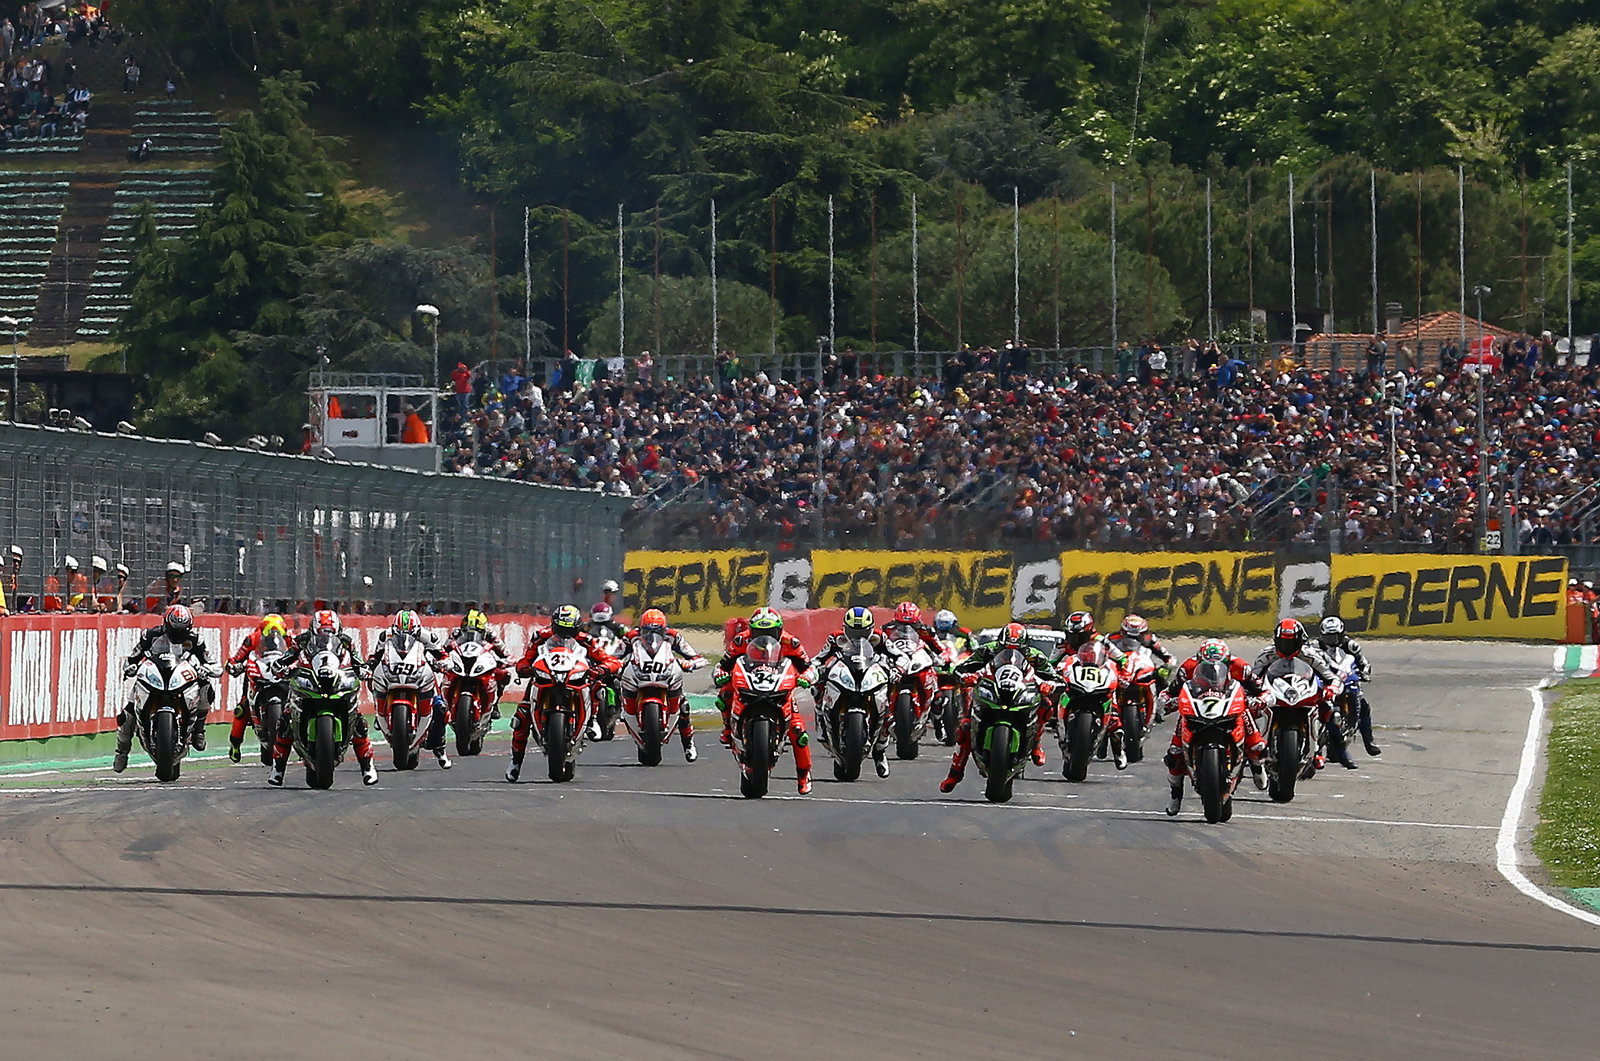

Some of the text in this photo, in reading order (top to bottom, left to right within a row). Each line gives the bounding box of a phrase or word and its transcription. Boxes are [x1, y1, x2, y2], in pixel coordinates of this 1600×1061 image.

[1486, 533, 1501, 546] 22
[1062, 555, 1275, 625] GAERNE
[1332, 558, 1566, 633] GAERNE
[392, 662, 415, 675] 69
[642, 661, 663, 674] 60
[752, 673, 775, 685] 34
[999, 669, 1020, 681] 66
[1080, 668, 1102, 684] 151
[1202, 698, 1219, 714] 7
